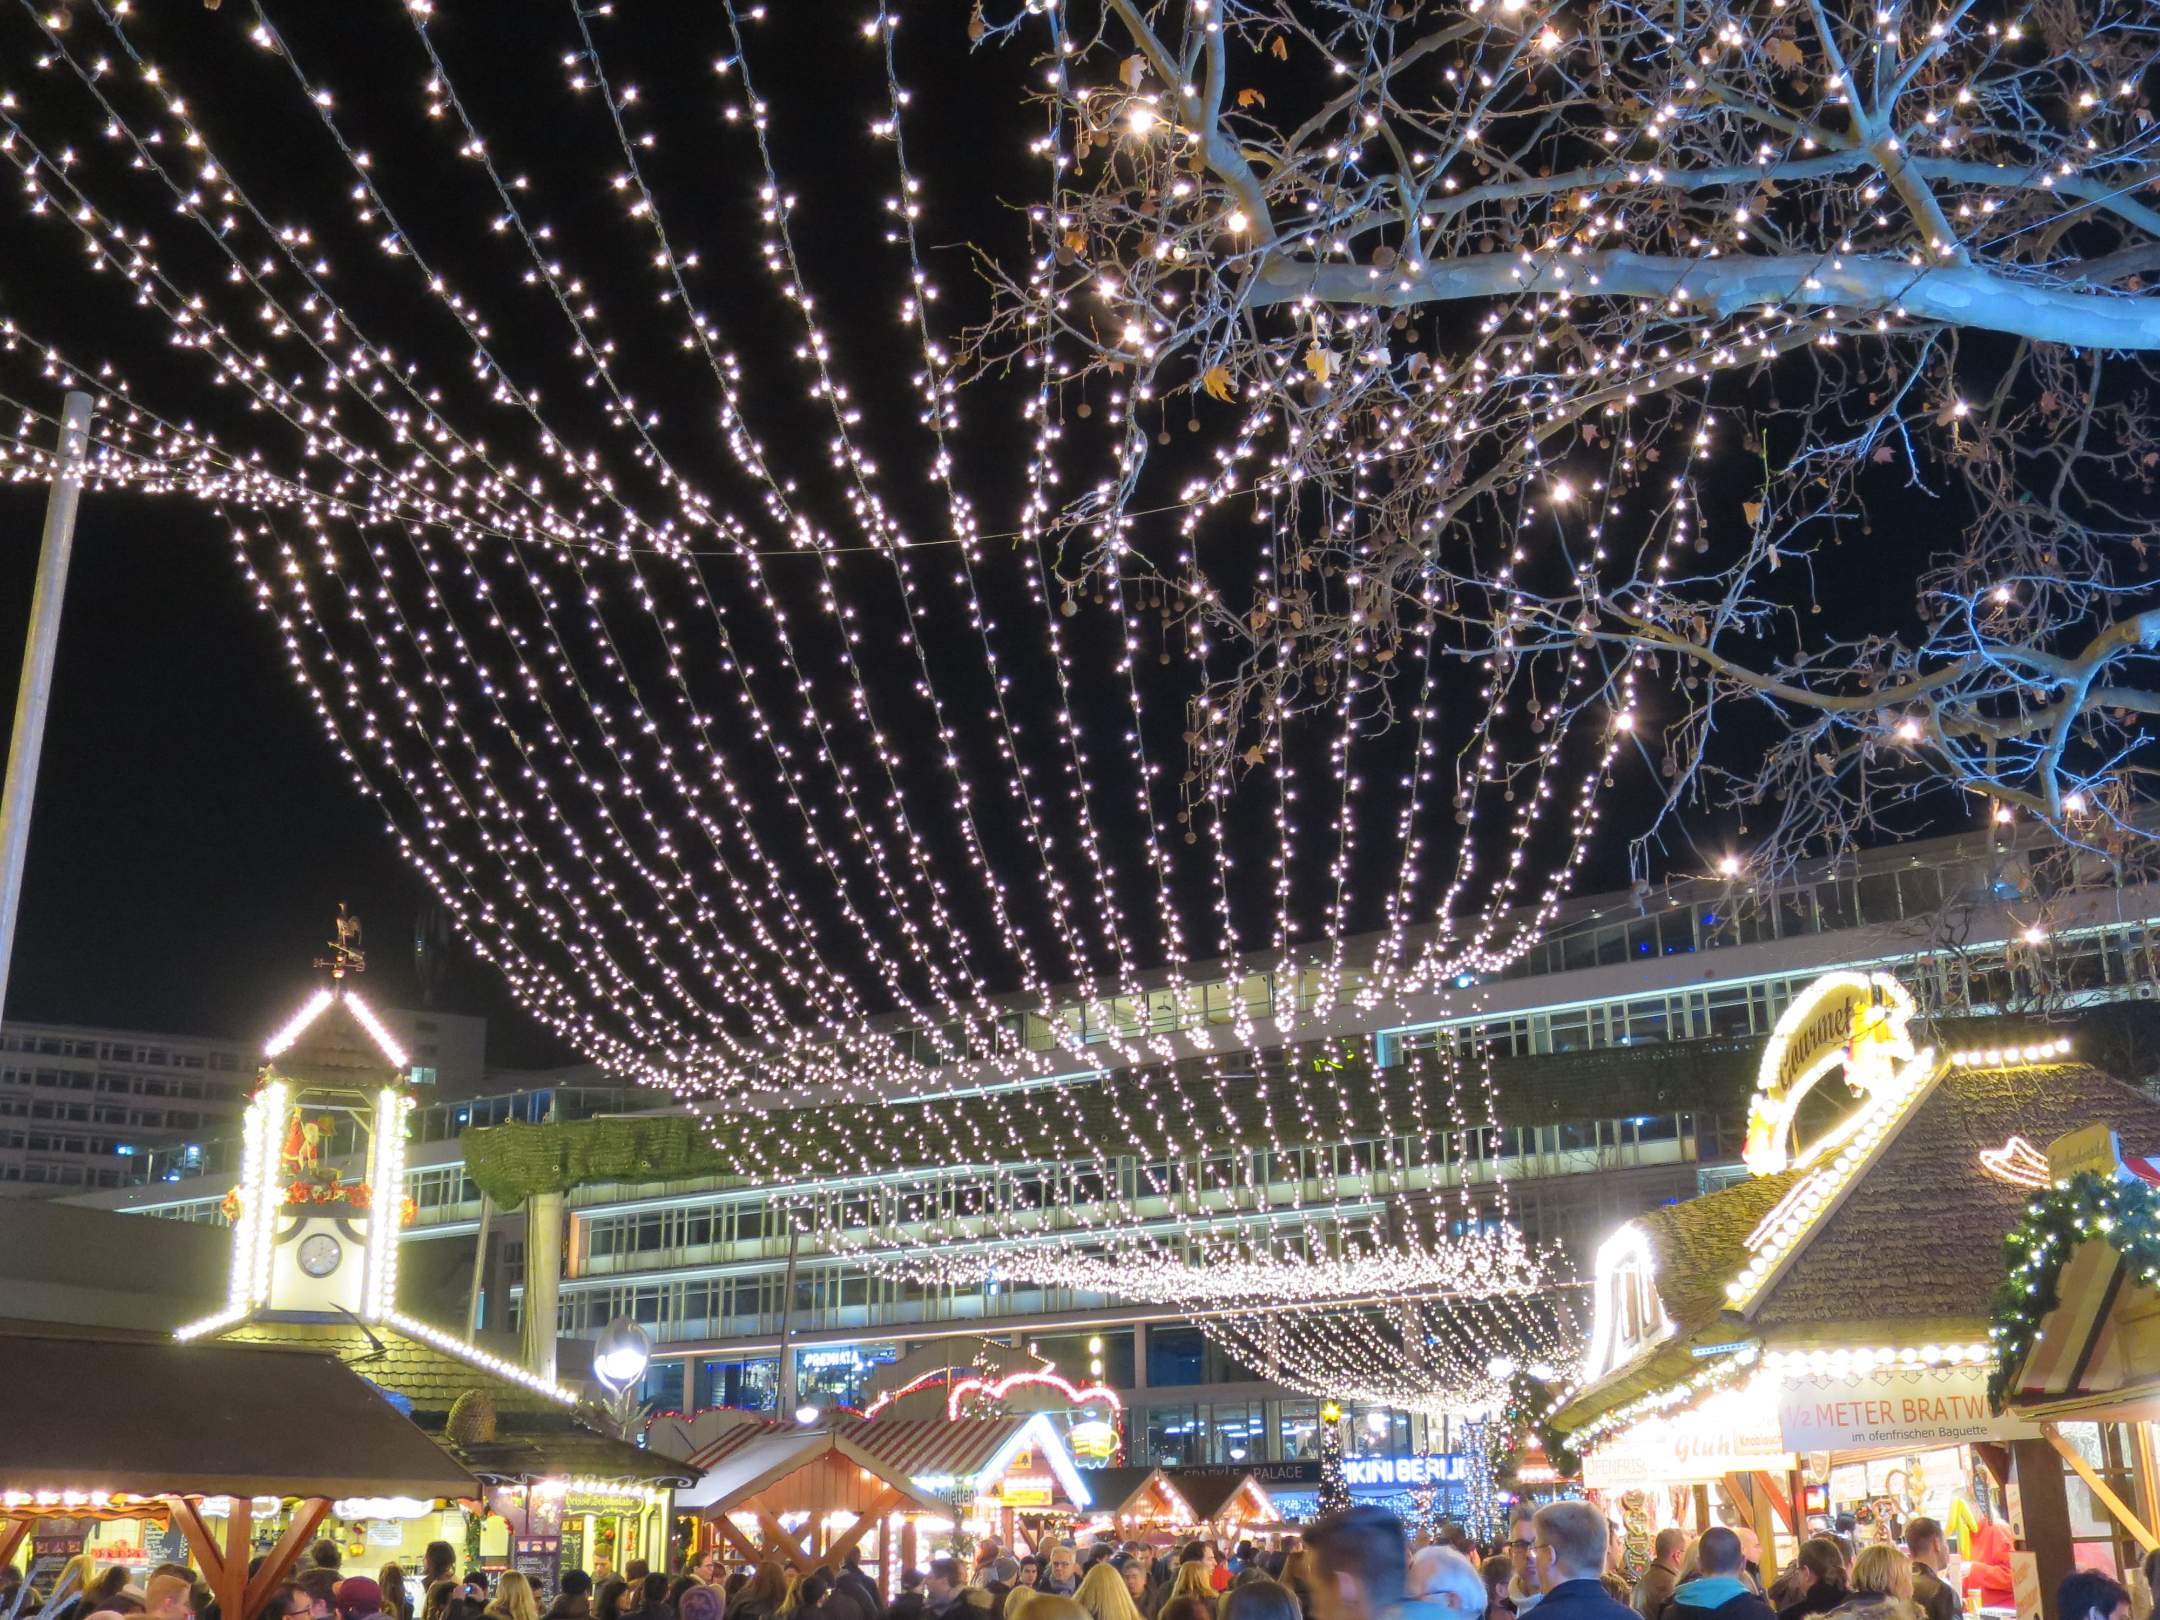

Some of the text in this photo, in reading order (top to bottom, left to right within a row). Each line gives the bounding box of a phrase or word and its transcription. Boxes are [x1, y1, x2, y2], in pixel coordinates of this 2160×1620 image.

[1780, 995, 1851, 1092] Gourmet
[804, 1351, 859, 1367] PREMIATA
[1815, 1400, 1896, 1428] METER
[1902, 1394, 2019, 1423] BRATW
[1851, 1425, 1988, 1443] im ofenfrischen Baguette
[1253, 1466, 1303, 1479] PALACE
[1340, 1460, 1394, 1484] IKINI
[935, 1486, 975, 1504] Toiletten
